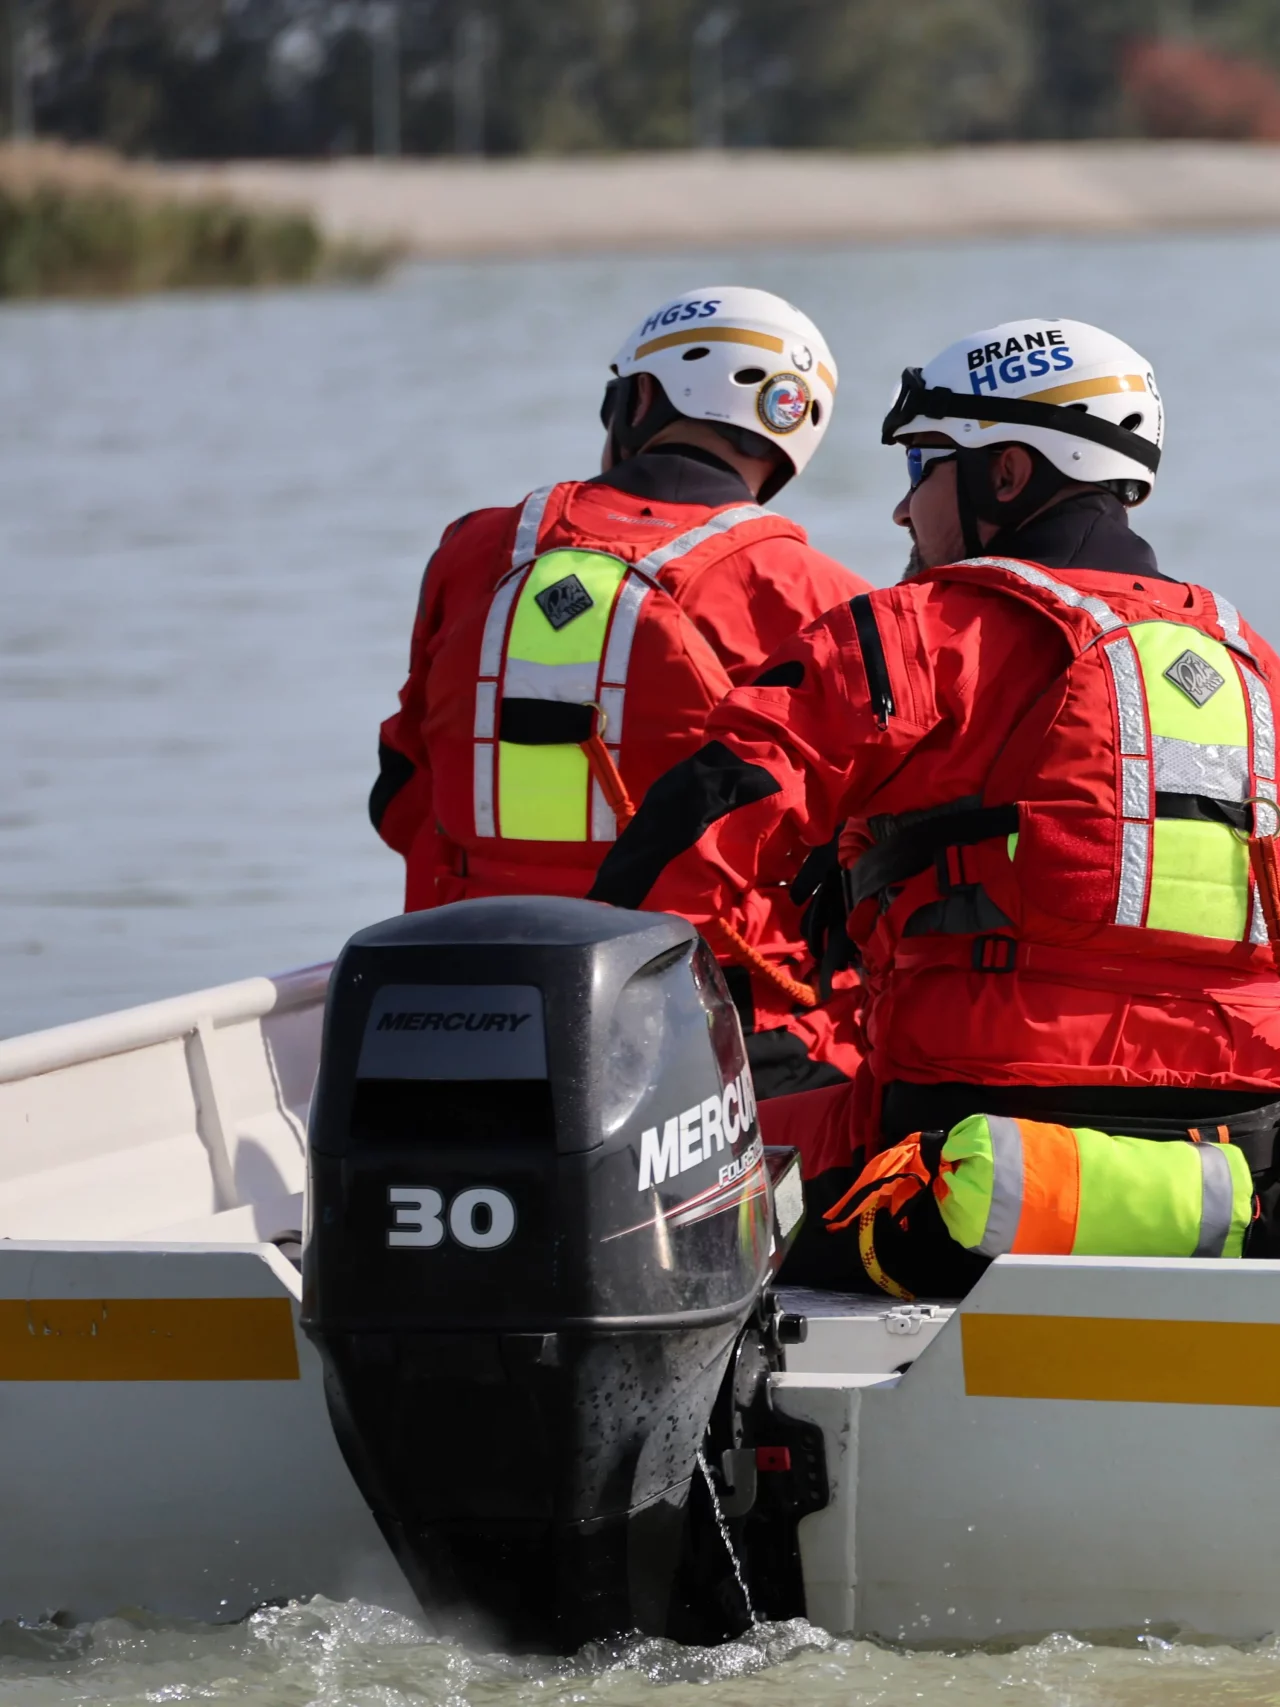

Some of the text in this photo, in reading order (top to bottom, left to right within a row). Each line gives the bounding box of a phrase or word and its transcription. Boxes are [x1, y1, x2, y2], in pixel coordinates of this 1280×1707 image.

[640, 300, 721, 336] HGSS
[967, 330, 1065, 370] BRANE
[969, 347, 1074, 395] HGSS
[376, 1012, 532, 1032] MERCURY
[638, 1060, 757, 1191] MERCUR
[388, 1186, 516, 1249] 30
